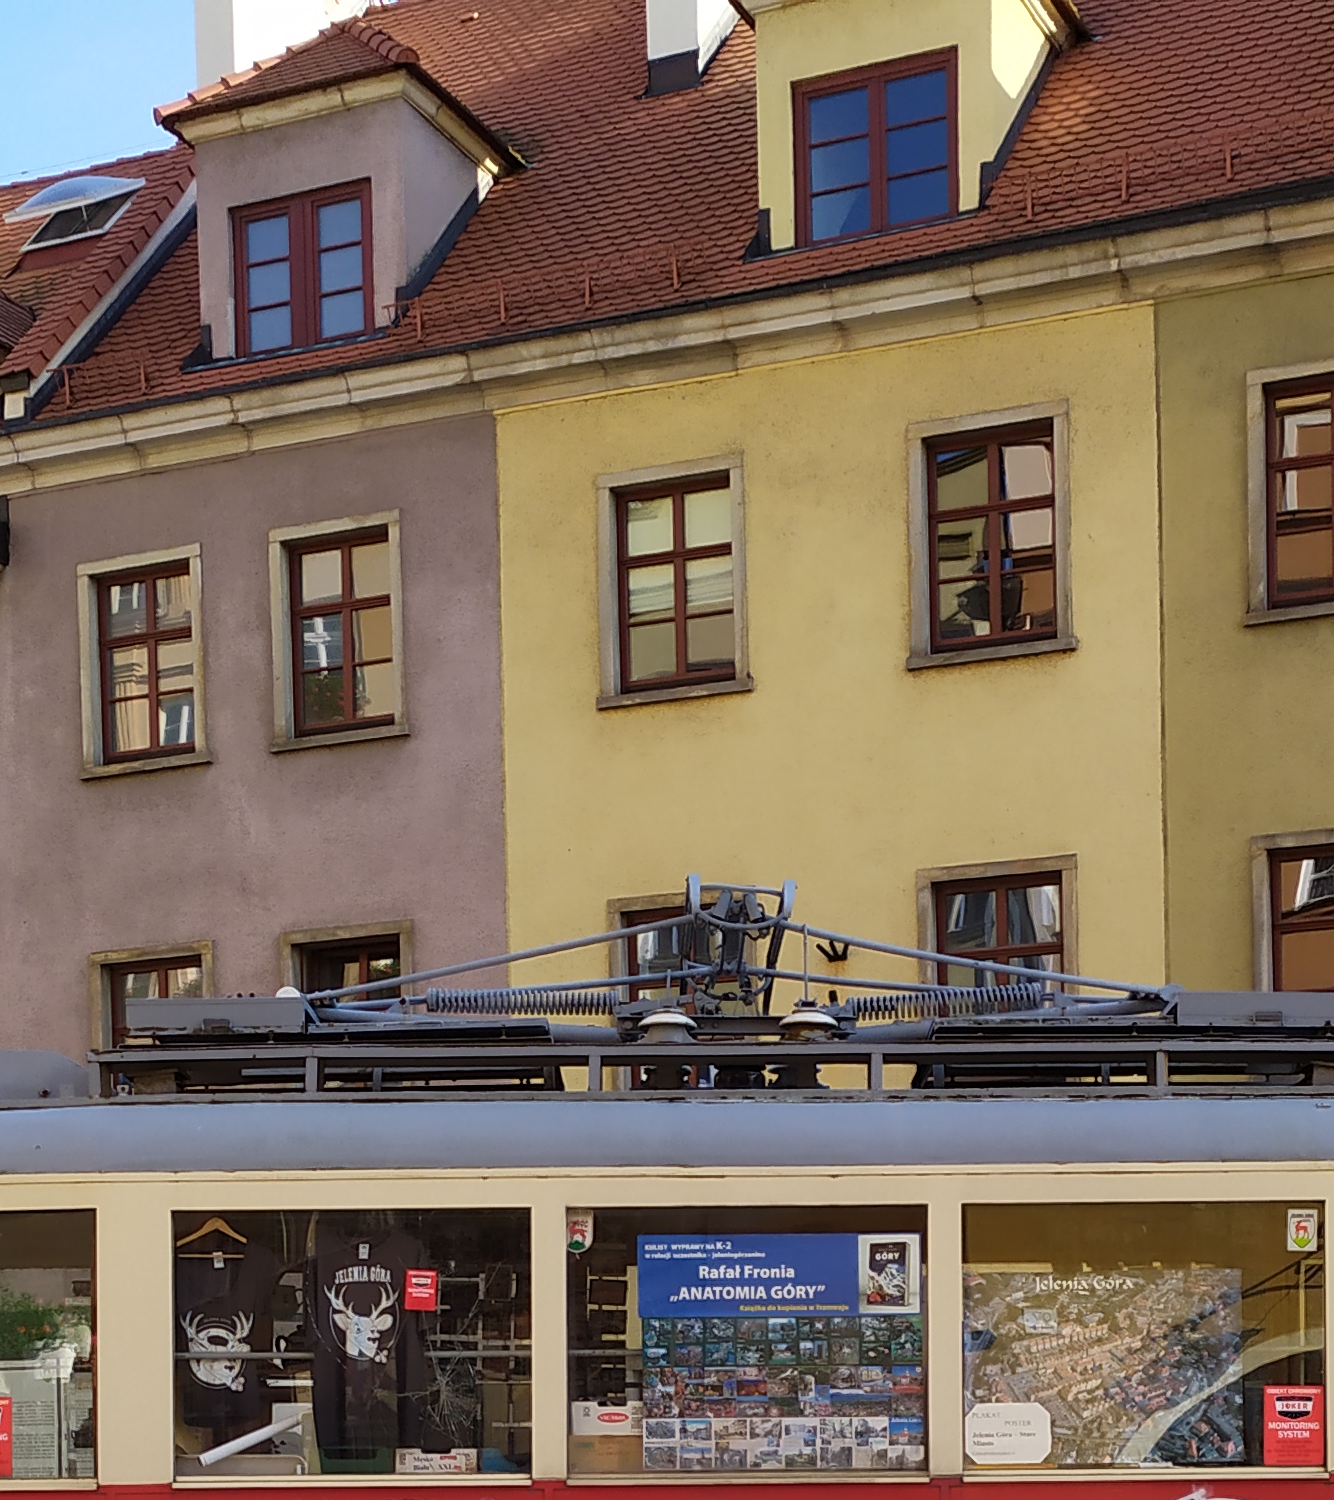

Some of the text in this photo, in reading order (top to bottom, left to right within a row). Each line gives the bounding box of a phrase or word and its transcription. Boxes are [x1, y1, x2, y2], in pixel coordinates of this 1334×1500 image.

[716, 1241, 732, 1250] K-2
[874, 1251, 900, 1261] GÓRY
[334, 1264, 392, 1285] JELENIA GÓRA
[698, 1264, 795, 1279] Rafał Fronia
[1035, 1274, 1135, 1296] Jelenia Góra
[1281, 1402, 1308, 1410] JOKER
[1268, 1422, 1320, 1430] MONITORING
[1278, 1430, 1310, 1438] SYSTEM
